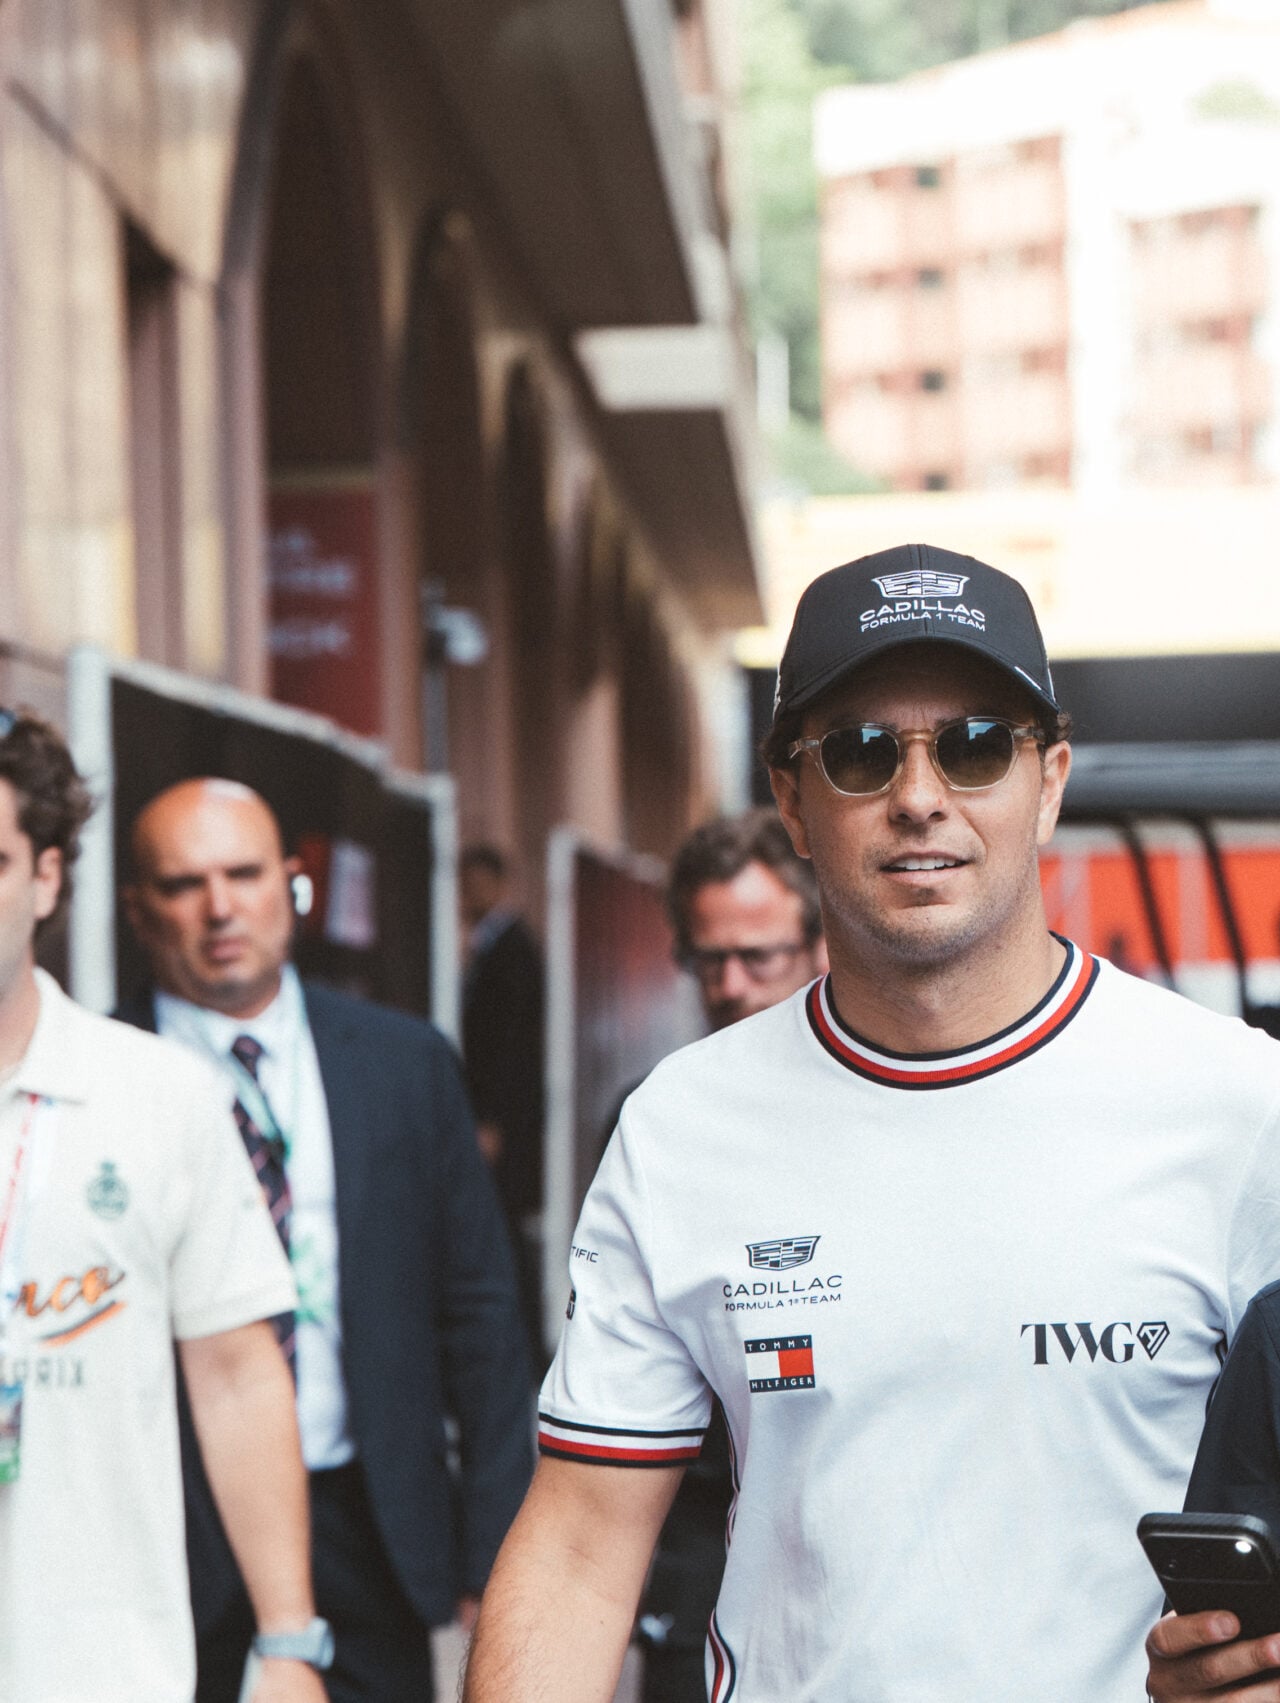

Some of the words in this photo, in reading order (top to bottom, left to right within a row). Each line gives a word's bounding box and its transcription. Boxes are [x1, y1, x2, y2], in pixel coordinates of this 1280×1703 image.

[859, 599, 986, 622] CADILLAC
[860, 611, 932, 633] FORMULA
[935, 613, 942, 621] 1
[948, 613, 986, 632] TEAM
[722, 1274, 843, 1298] CADILLAC
[725, 1299, 785, 1312] FORMULA
[800, 1293, 841, 1305] TEAM
[747, 1338, 809, 1353] TOMMY
[1020, 1322, 1136, 1365] TWG
[751, 1376, 813, 1390] HILFIGER
